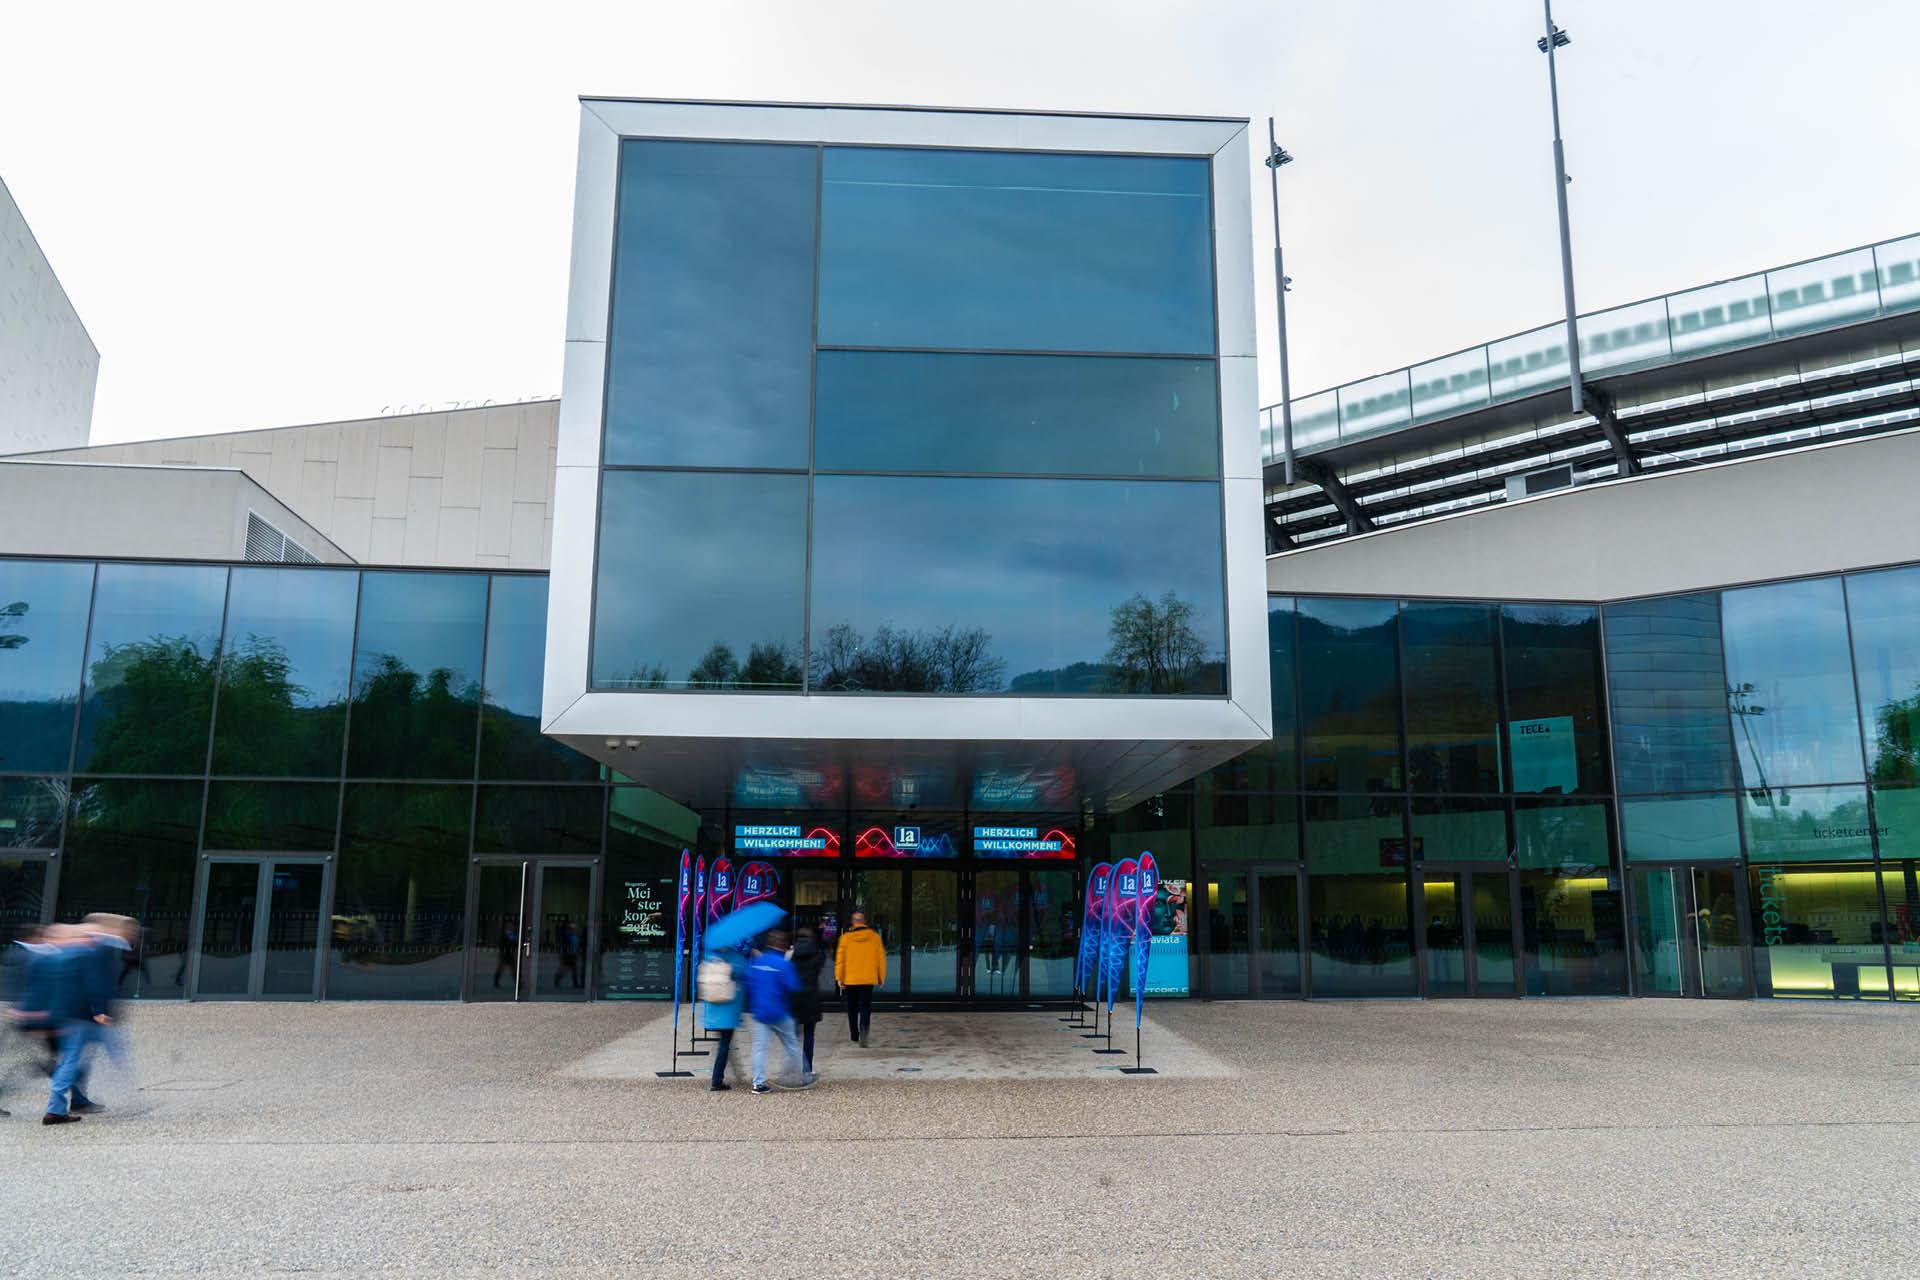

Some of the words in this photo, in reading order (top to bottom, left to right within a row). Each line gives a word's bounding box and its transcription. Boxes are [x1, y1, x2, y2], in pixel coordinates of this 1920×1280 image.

[744, 827, 798, 835] HERZLICH
[982, 828, 1034, 837] HERZLICH
[1813, 826, 1889, 839] ticketcener
[744, 839, 821, 849] WILLKOMMEN!
[982, 841, 1057, 850] WILLKOMMEN!
[627, 887, 651, 899] Mei
[637, 901, 662, 910] ster
[1759, 866, 1787, 945] tickets
[1151, 936, 1179, 944] aviata
